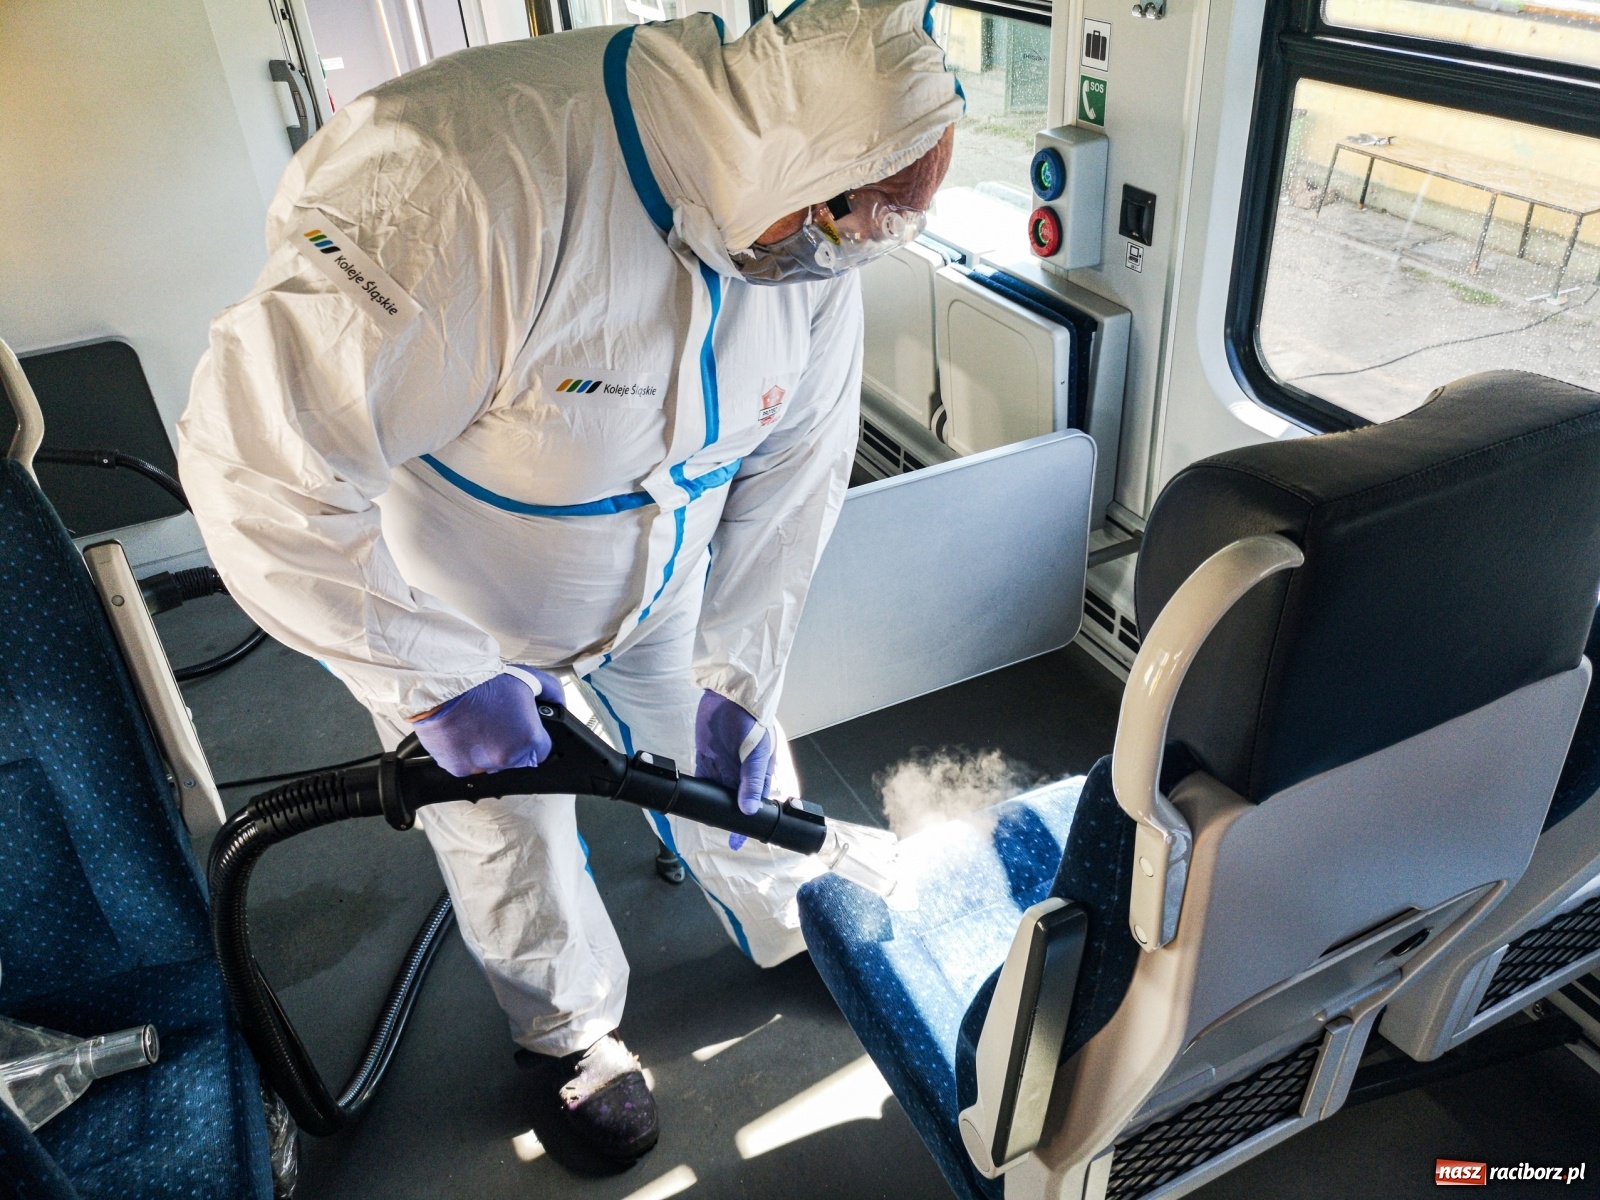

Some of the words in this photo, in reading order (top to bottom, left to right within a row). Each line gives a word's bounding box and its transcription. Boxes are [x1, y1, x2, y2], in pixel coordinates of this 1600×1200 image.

[1090, 81, 1105, 93] SOS
[334, 255, 364, 284] Koleje
[362, 280, 398, 316] Śląskie
[603, 383, 630, 397] Koleje
[631, 383, 657, 397] Śląskie
